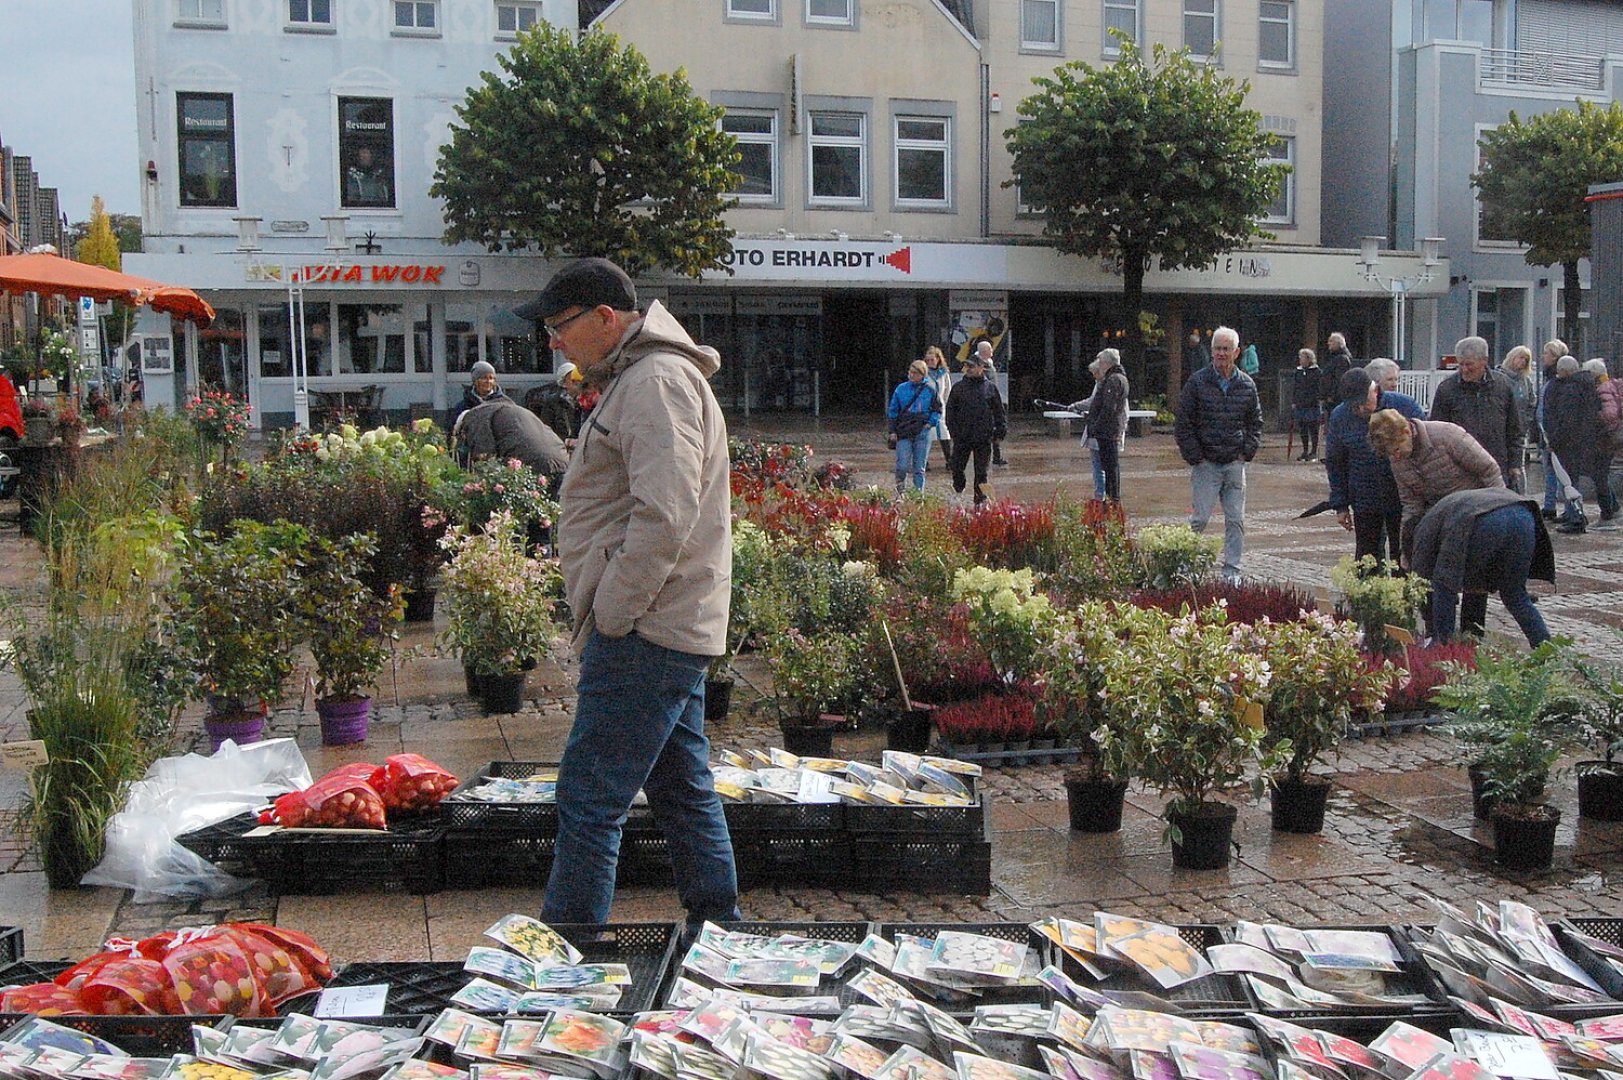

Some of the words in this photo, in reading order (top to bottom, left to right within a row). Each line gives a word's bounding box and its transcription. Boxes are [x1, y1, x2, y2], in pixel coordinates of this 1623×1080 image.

[184, 117, 228, 127] Restaurant
[345, 120, 387, 130] Restaurant
[719, 249, 765, 266] OTO
[772, 249, 875, 268] ERHARDT
[372, 265, 446, 284] WOK
